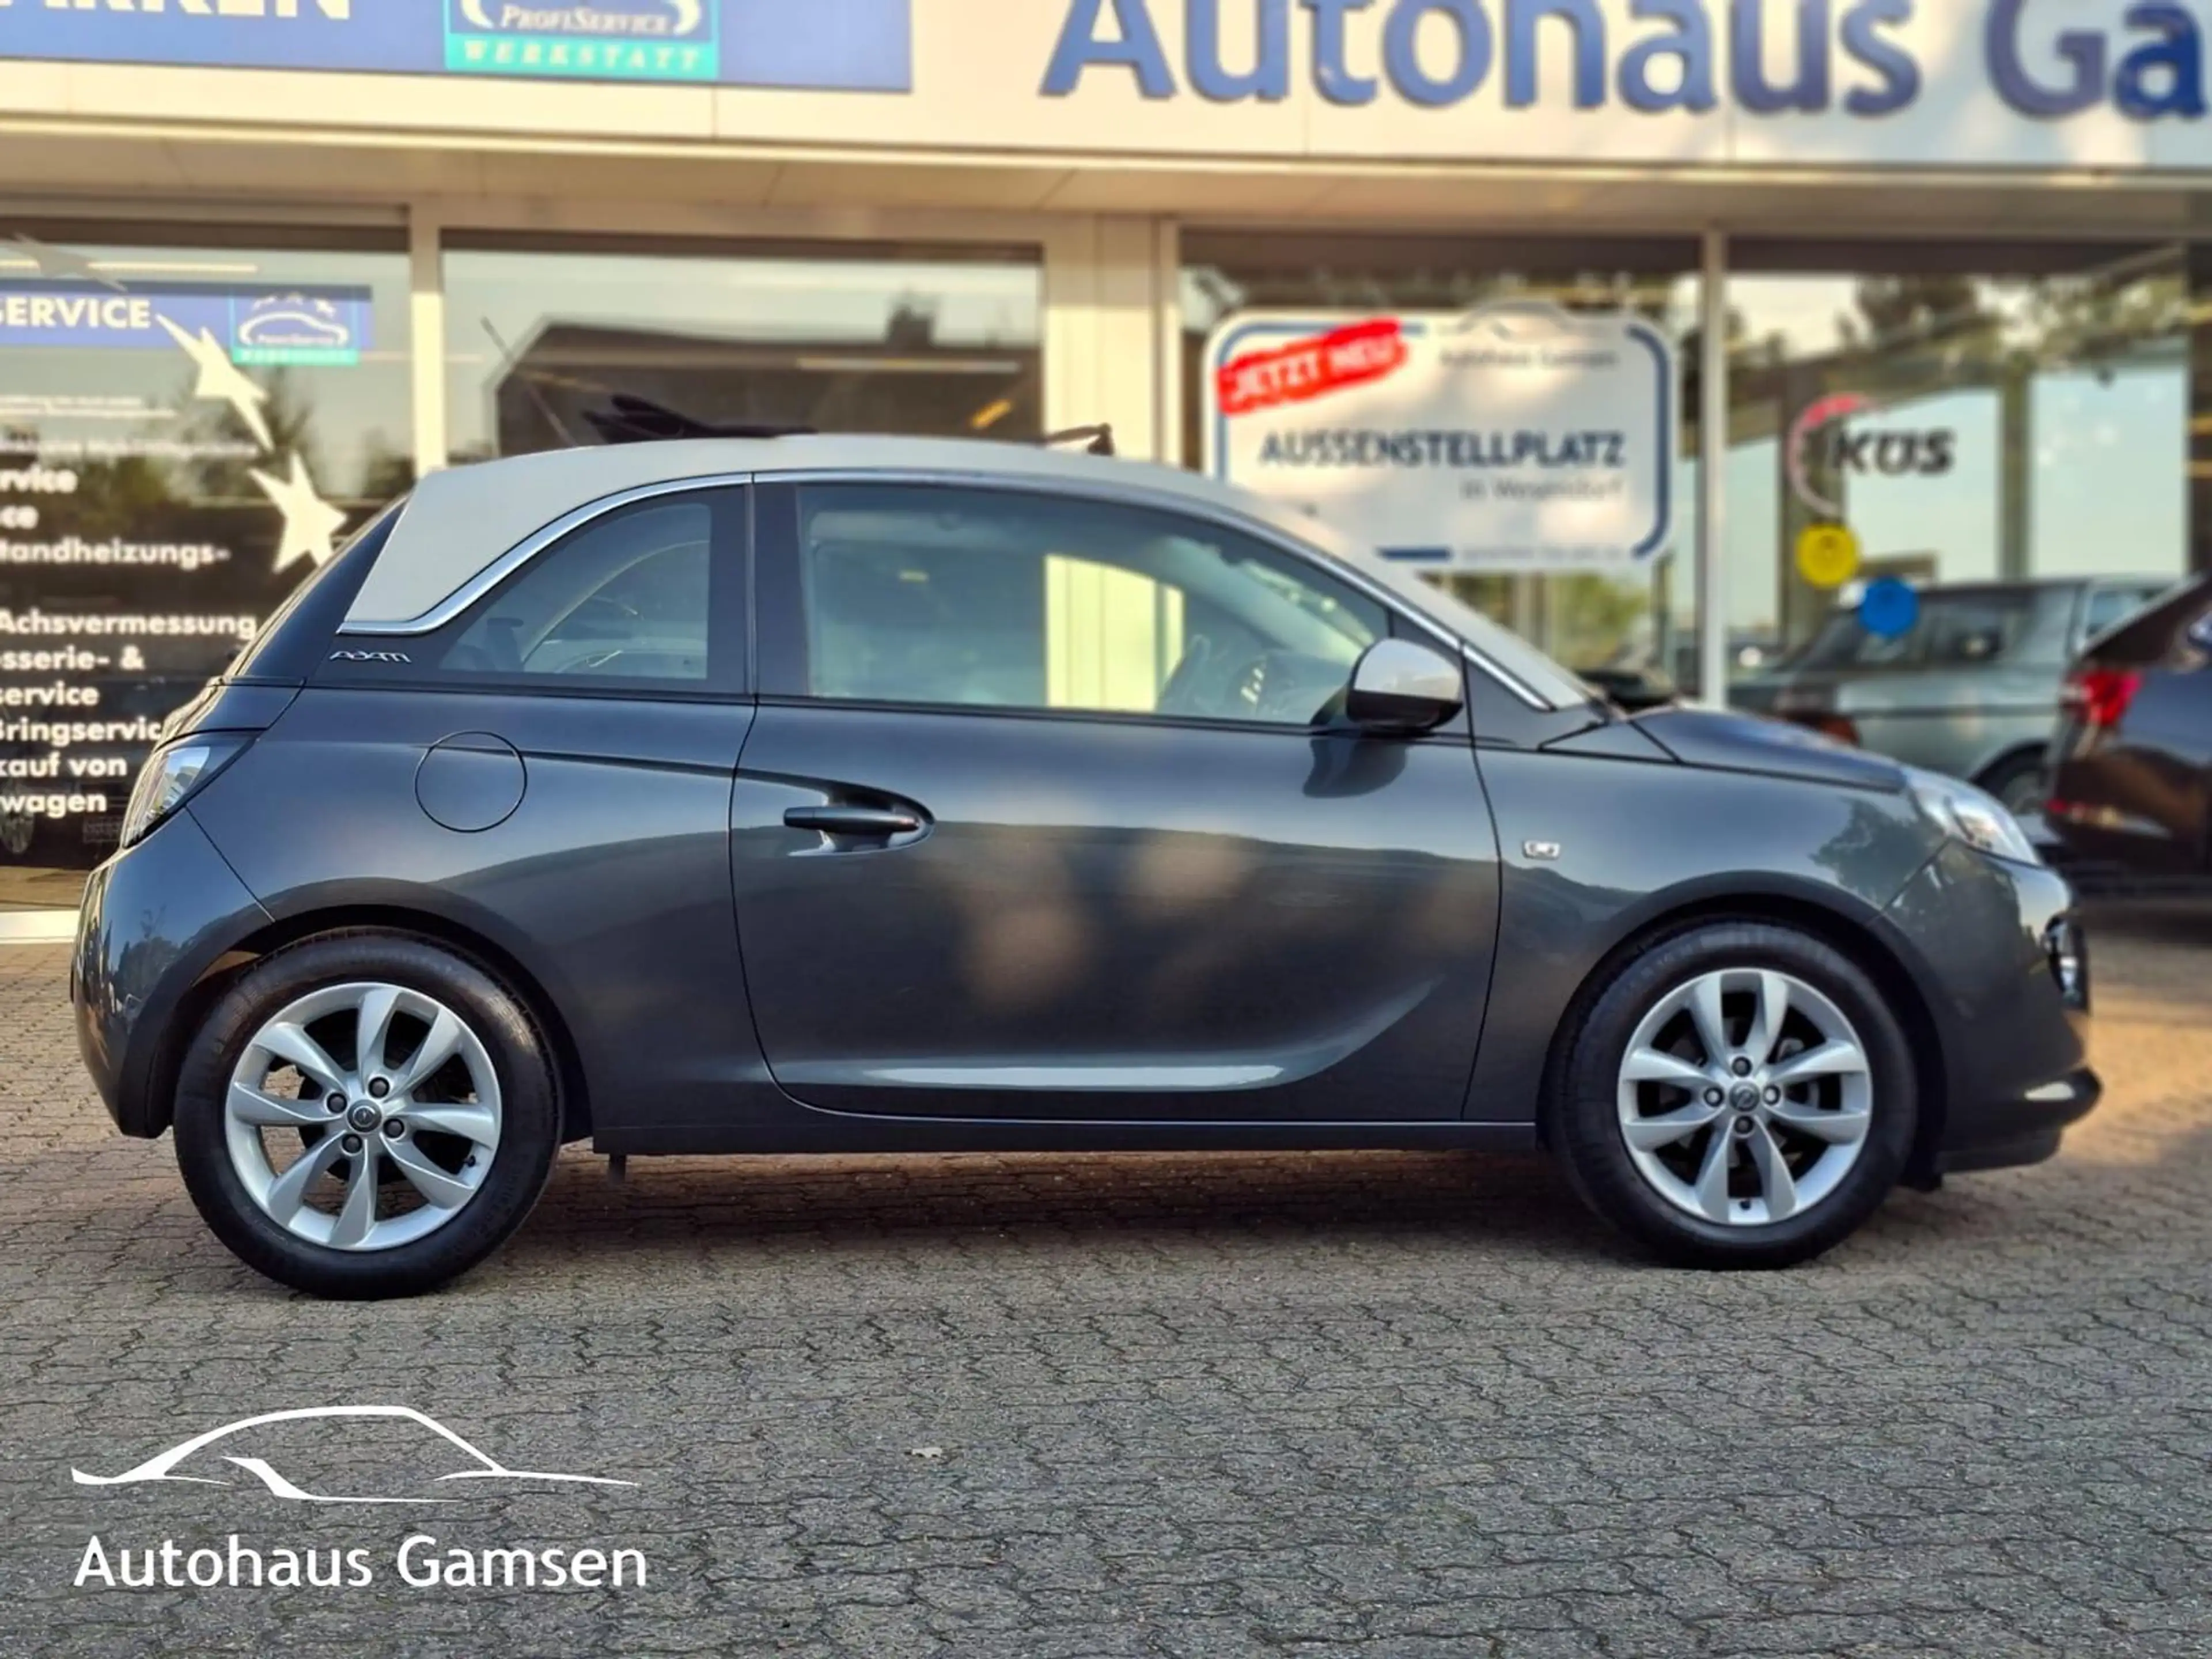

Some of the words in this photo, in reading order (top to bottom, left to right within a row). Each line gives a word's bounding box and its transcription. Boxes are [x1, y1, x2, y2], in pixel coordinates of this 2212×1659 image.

[1037, 0, 1921, 117] Autohaus
[1985, 0, 2211, 122] Ga
[0, 296, 151, 329] ERVICE
[1260, 430, 1626, 467] AUSSENSTELLPLATZ
[0, 608, 257, 641] Achsvermessung
[119, 645, 145, 671] &
[0, 680, 100, 706] ervice
[67, 757, 127, 777] von
[0, 794, 108, 819] wagen
